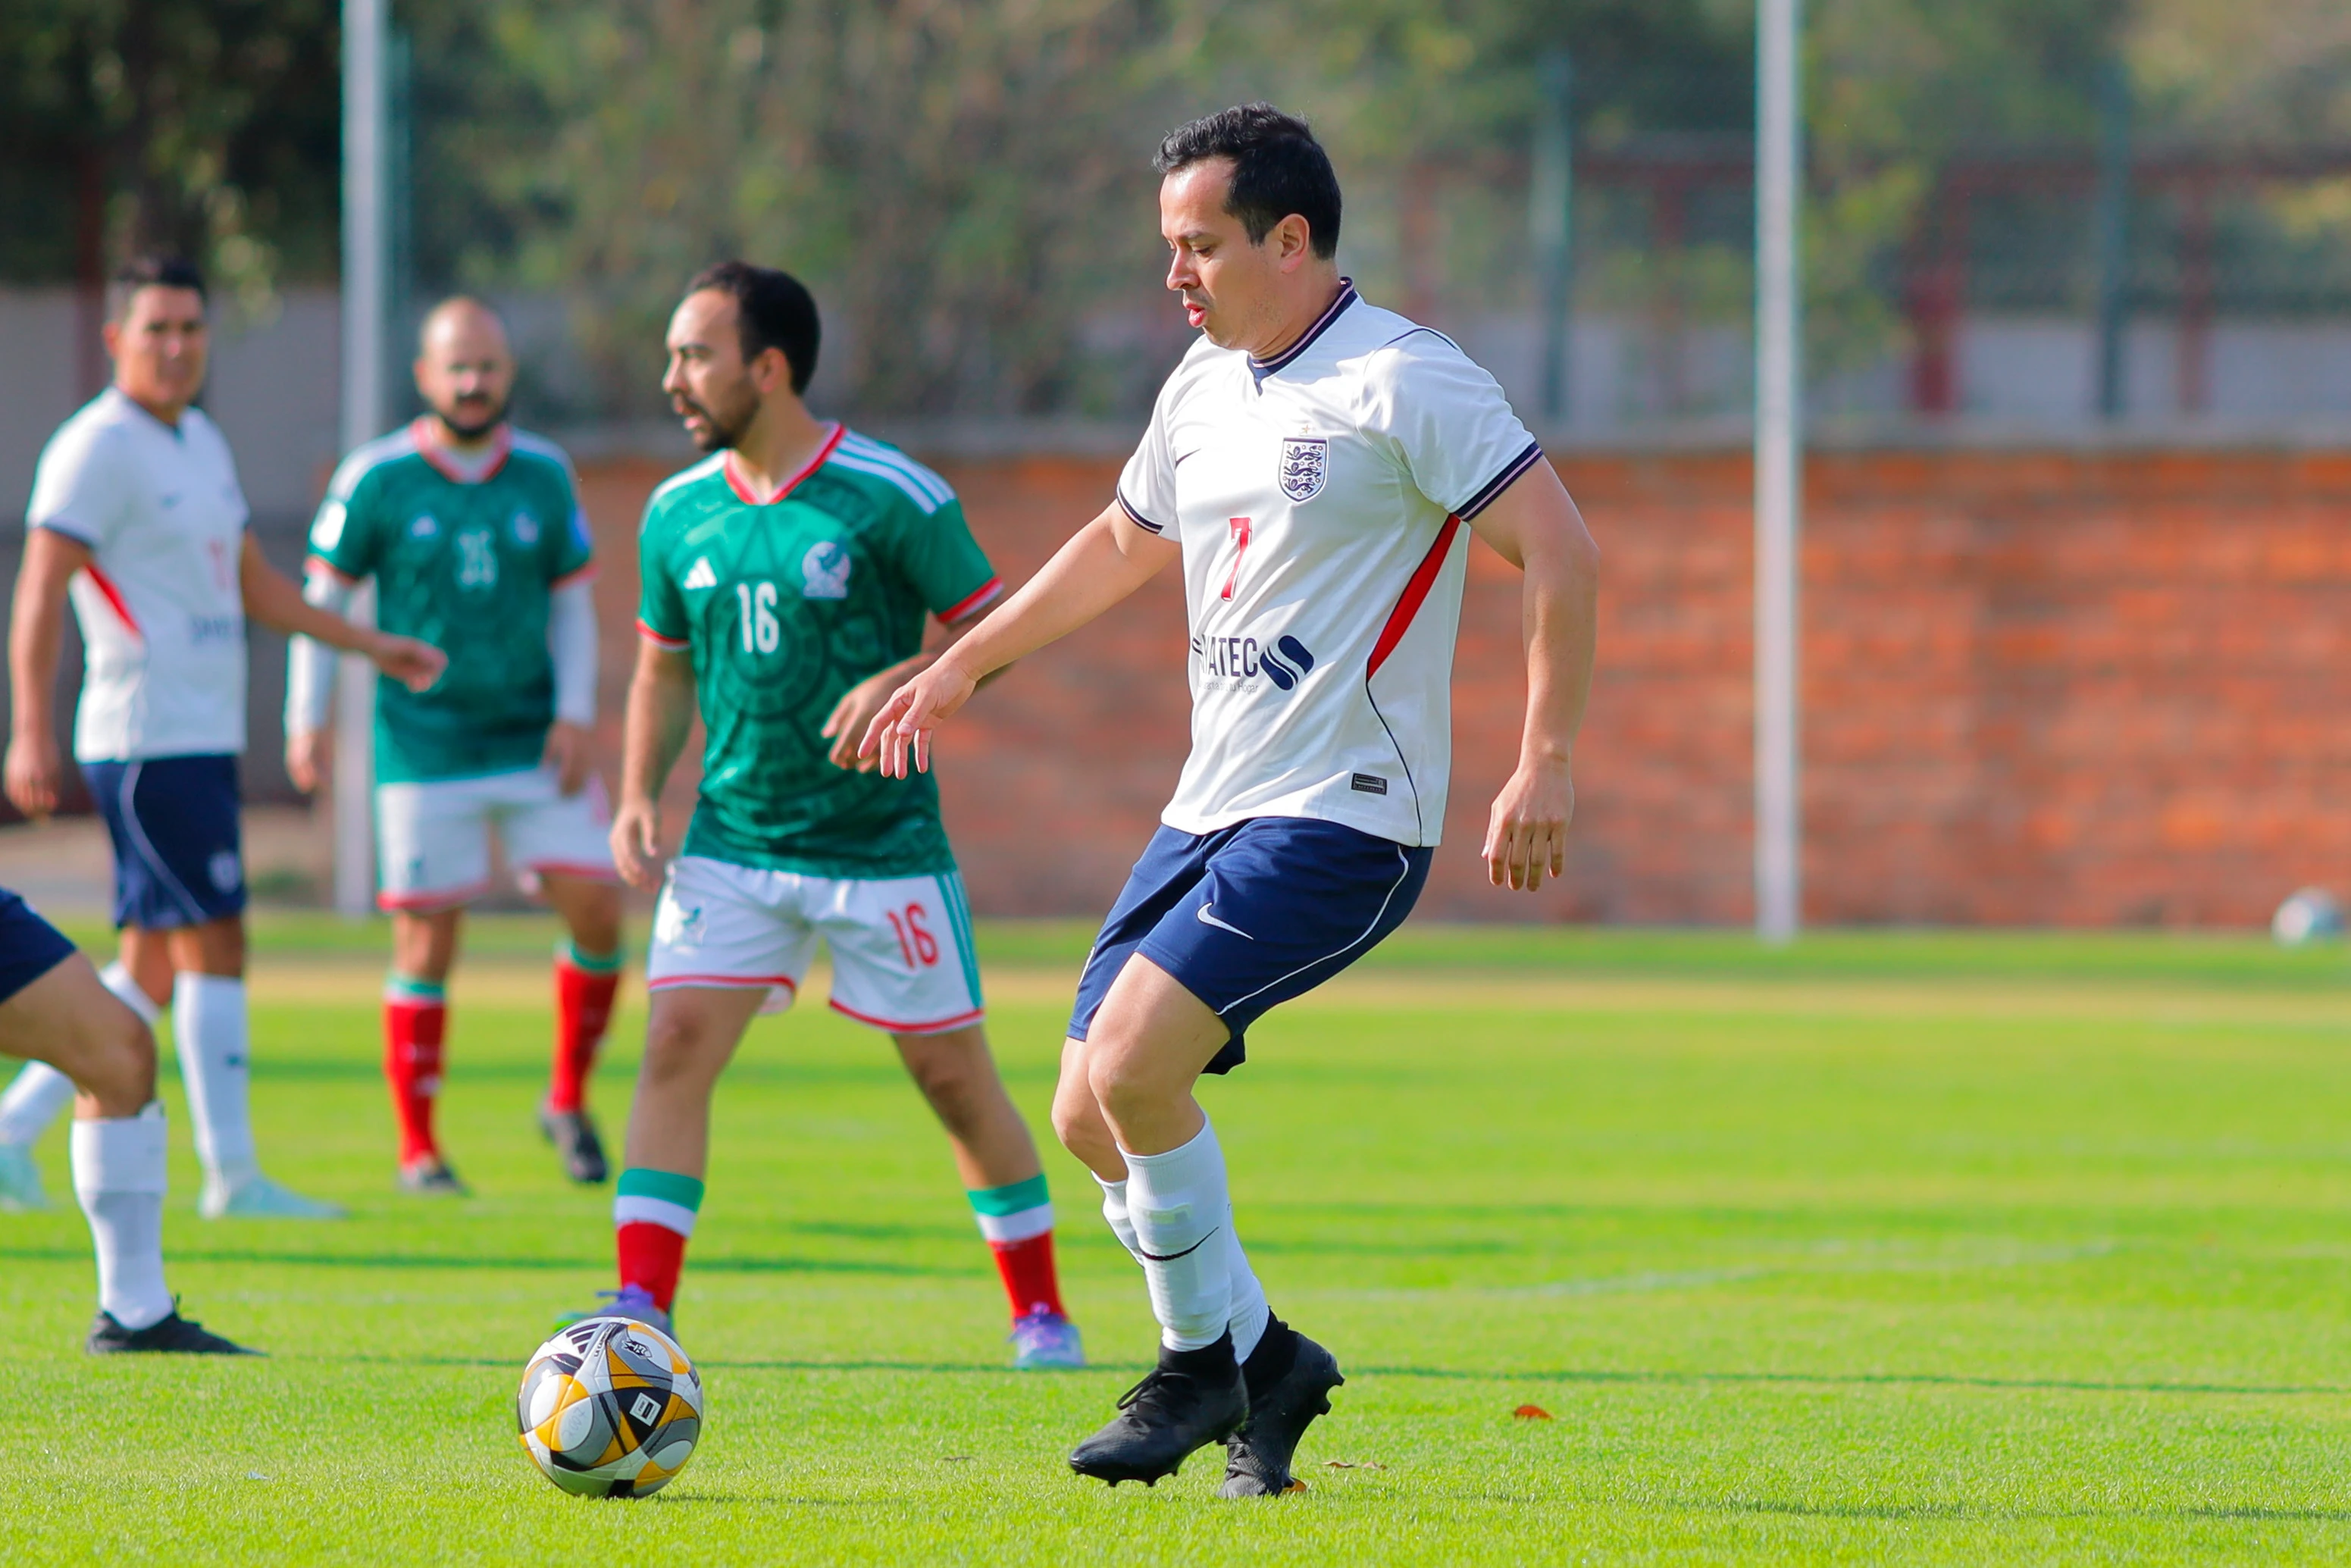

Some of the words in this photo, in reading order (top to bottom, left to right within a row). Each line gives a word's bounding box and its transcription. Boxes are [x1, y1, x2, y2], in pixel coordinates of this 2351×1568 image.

[1221, 517, 1252, 602] 7
[737, 581, 779, 653] 16
[887, 903, 938, 970] 16
